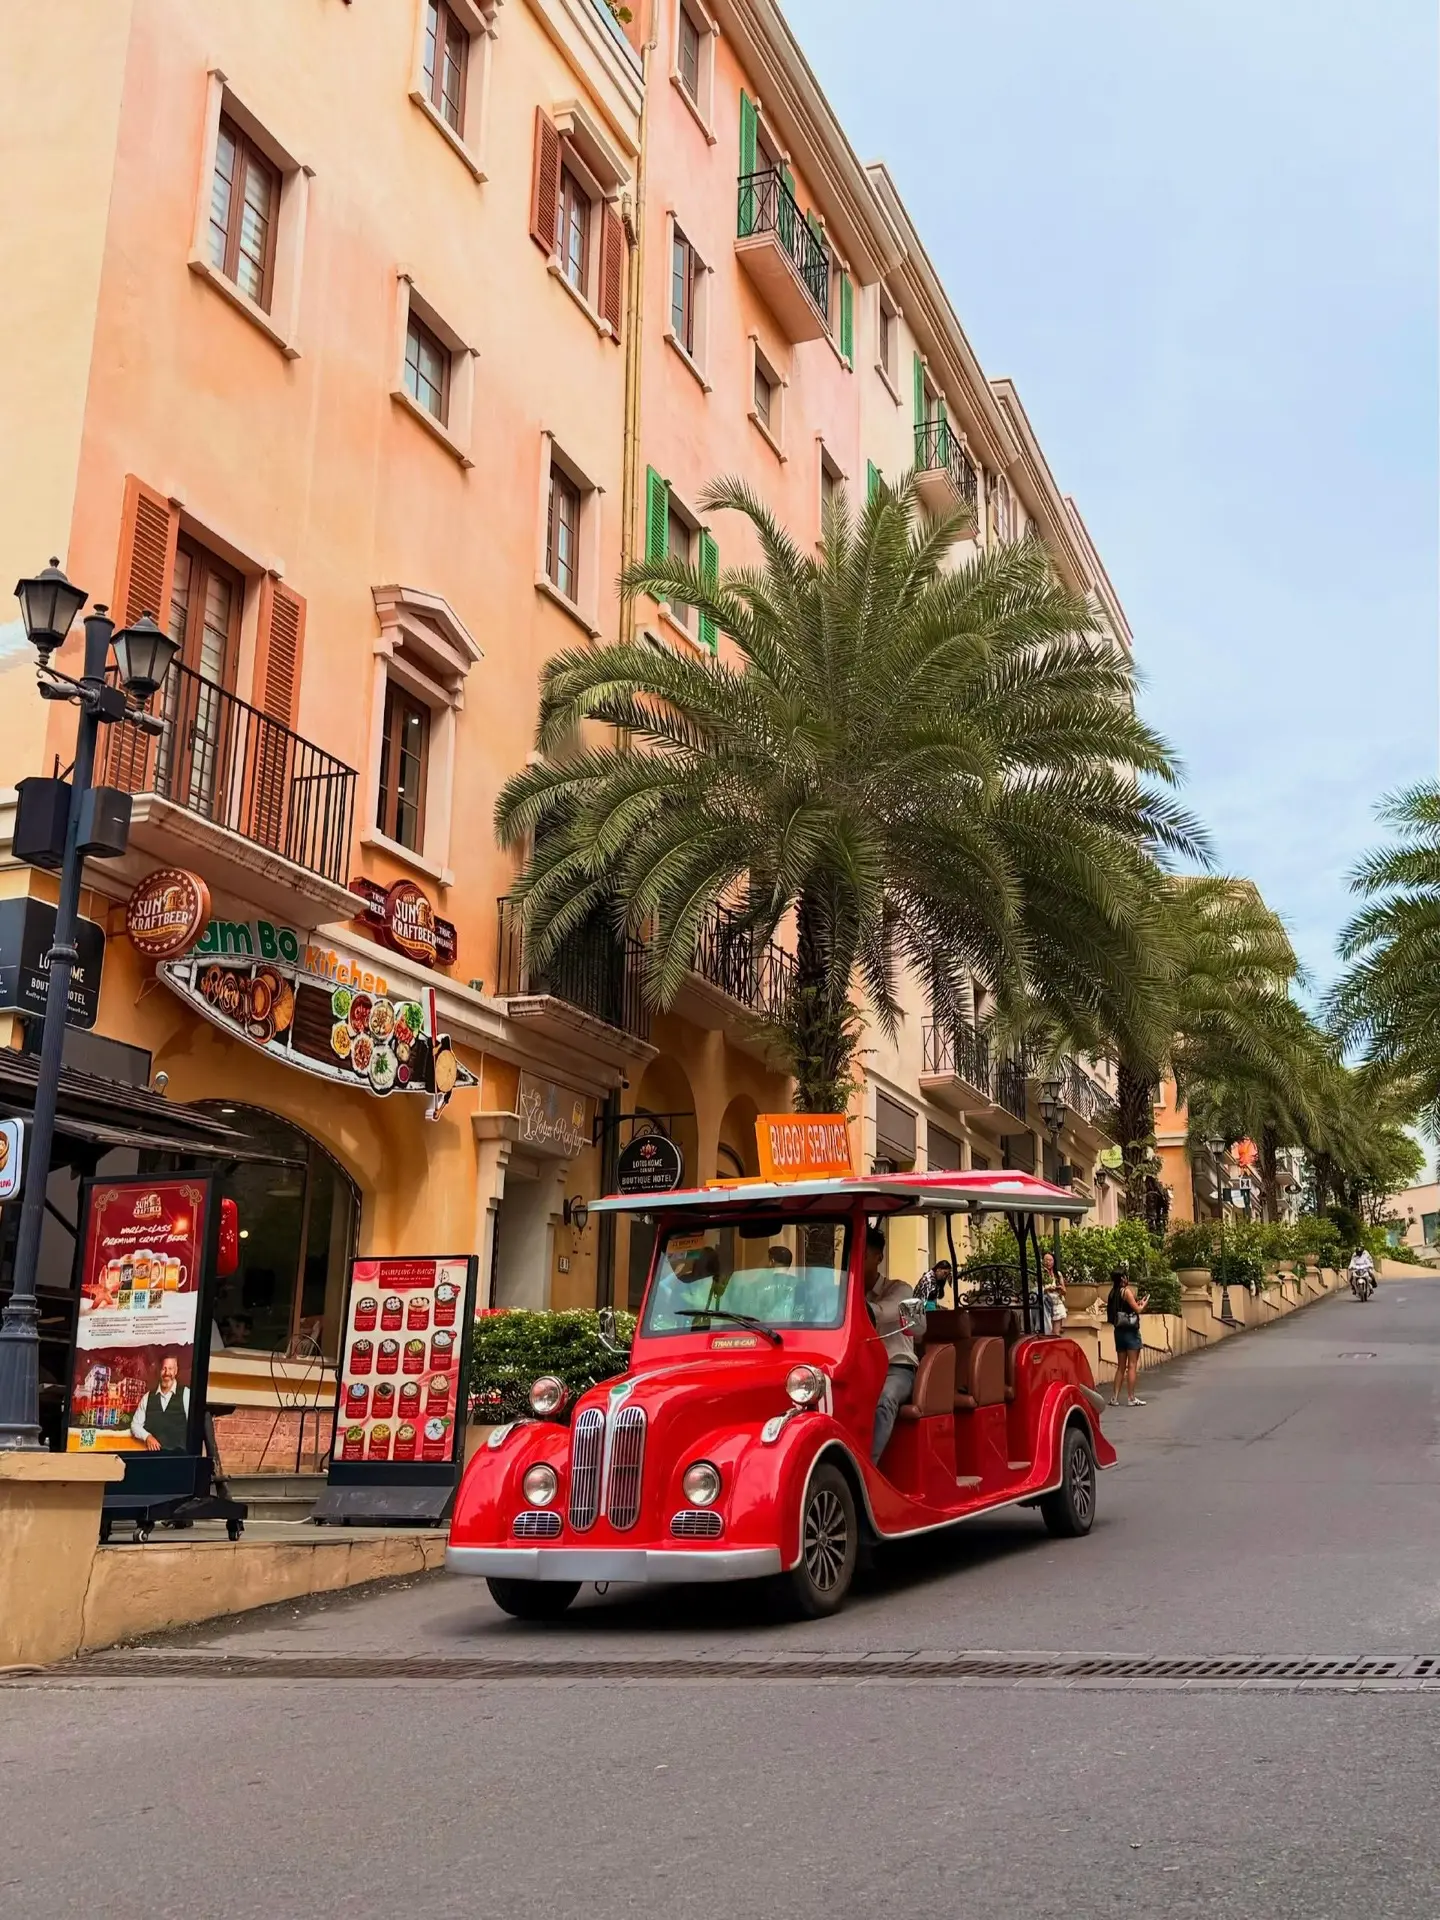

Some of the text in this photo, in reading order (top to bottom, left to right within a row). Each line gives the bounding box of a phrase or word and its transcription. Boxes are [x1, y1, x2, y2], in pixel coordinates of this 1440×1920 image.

[136, 896, 162, 917] SUN
[371, 891, 385, 904] TRUE
[131, 910, 189, 931] KRAFTBEER
[370, 901, 386, 919] BEER
[395, 898, 417, 924] SUN
[184, 919, 255, 957] am
[392, 914, 437, 949] KRAFTBEER
[304, 945, 388, 996] Kitchen
[769, 1123, 848, 1165] BUGGY SERVICE
[632, 1158, 663, 1169] LOTUS HOME
[621, 1174, 673, 1185] BOUTIQUE HOTEL
[120, 1224, 172, 1234] WORLD-CLASS
[102, 1233, 188, 1247] PREMIUM CRAFT BEER
